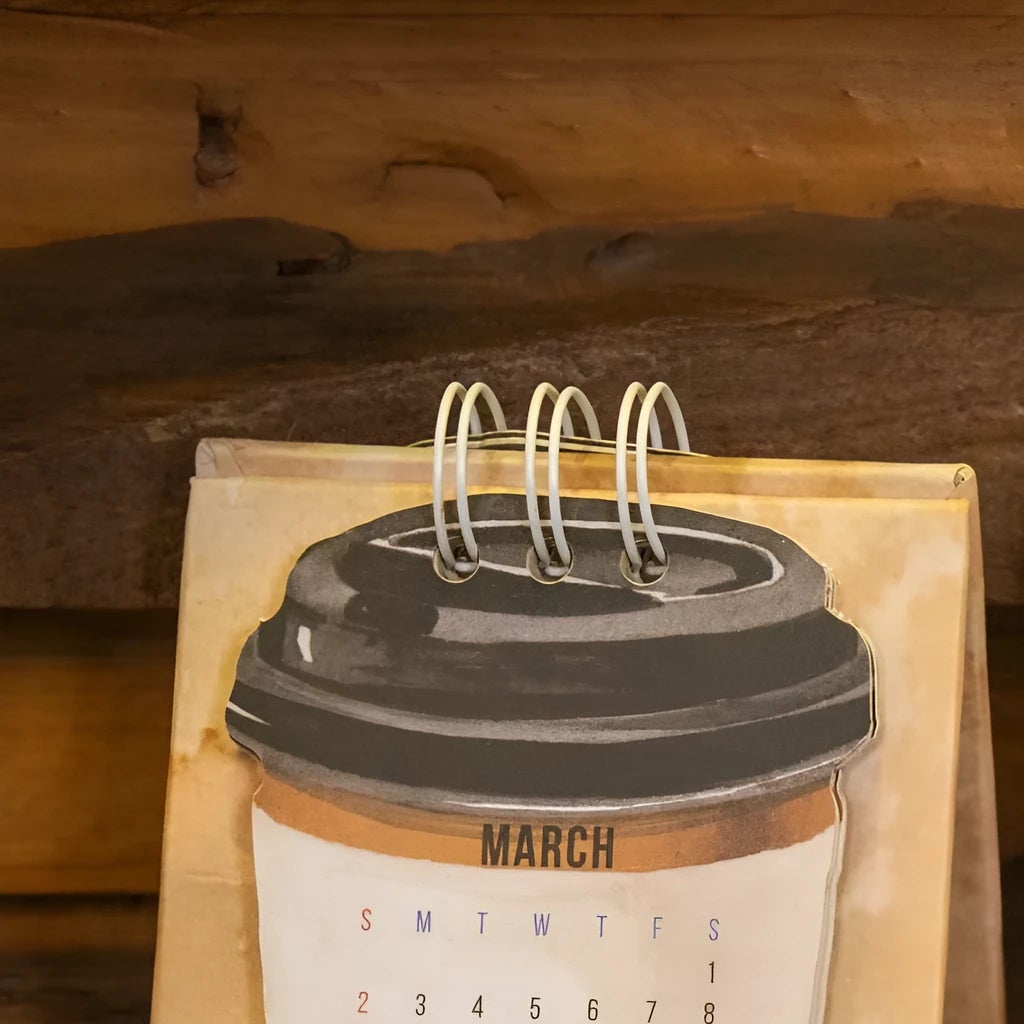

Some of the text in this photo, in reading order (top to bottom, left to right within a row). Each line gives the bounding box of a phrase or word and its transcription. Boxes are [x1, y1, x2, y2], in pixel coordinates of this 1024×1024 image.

[481, 823, 614, 869] MARCH
[360, 907, 720, 942] S M T W T F S
[708, 960, 715, 984] 1
[356, 991, 715, 1024] 2 3 4 5 6 7 8
